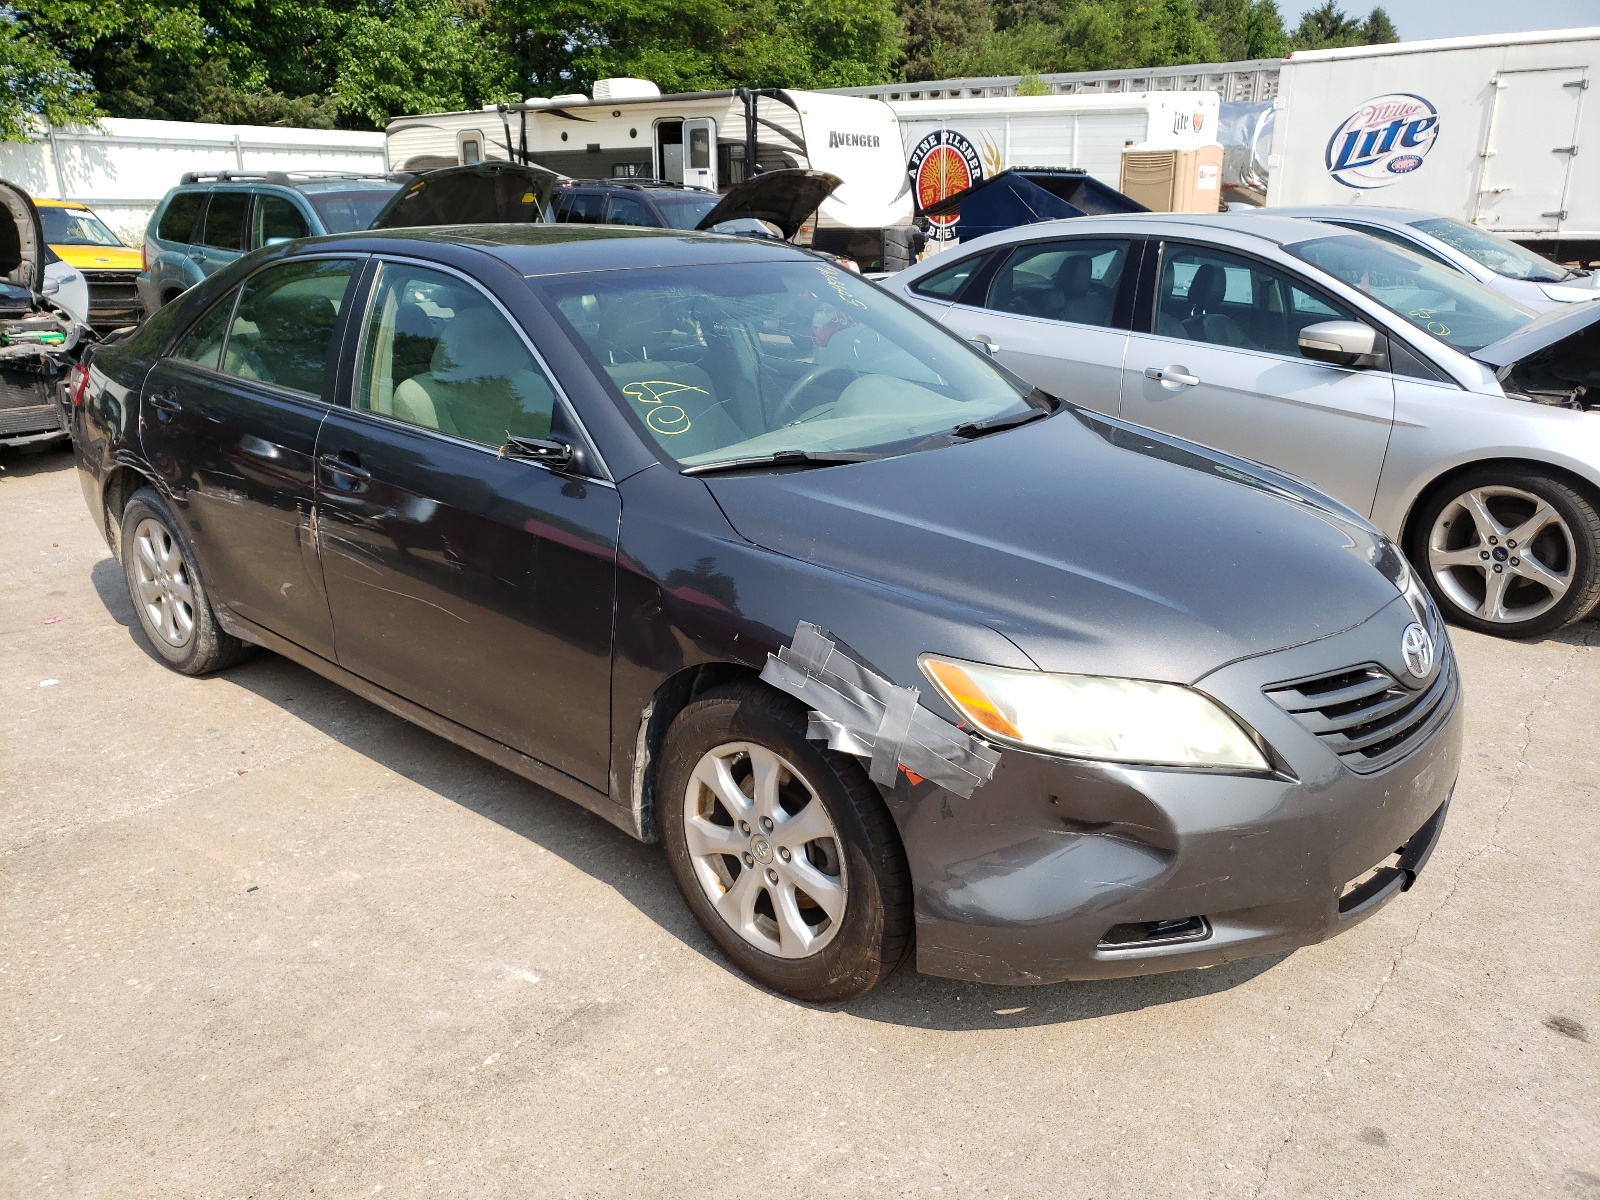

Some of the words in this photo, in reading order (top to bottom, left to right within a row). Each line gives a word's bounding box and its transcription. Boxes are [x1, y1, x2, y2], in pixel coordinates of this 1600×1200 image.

[1173, 110, 1189, 135] Lite
[1360, 103, 1421, 123] Miller
[829, 130, 880, 149] AVENGER
[912, 134, 938, 165] FINE
[1330, 115, 1438, 171] Lite
[941, 132, 981, 180] PILSNER
[908, 169, 917, 179] A
